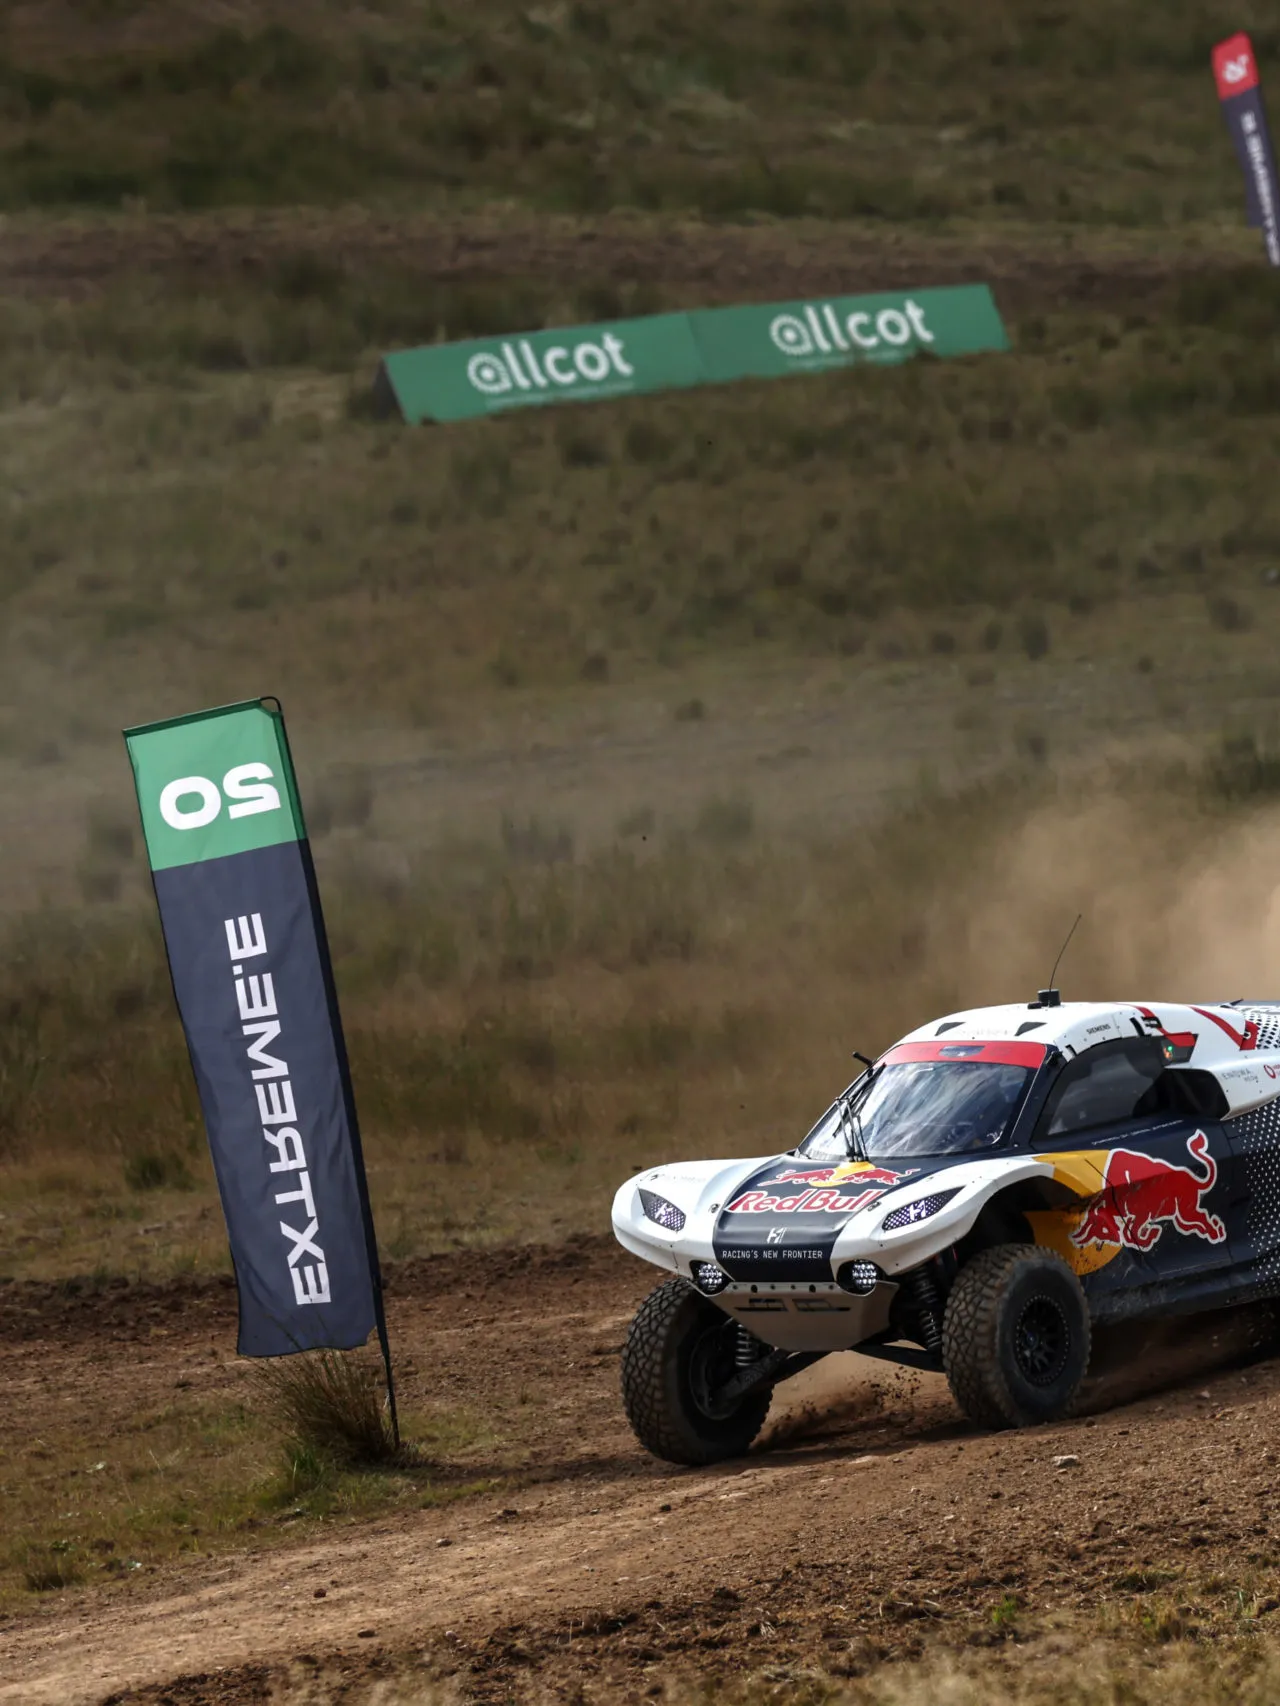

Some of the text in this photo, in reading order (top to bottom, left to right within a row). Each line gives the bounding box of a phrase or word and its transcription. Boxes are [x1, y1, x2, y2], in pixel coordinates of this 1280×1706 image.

[725, 1189, 817, 1212] Red
[722, 1250, 823, 1259] RACING'S NEW FRONTIER
